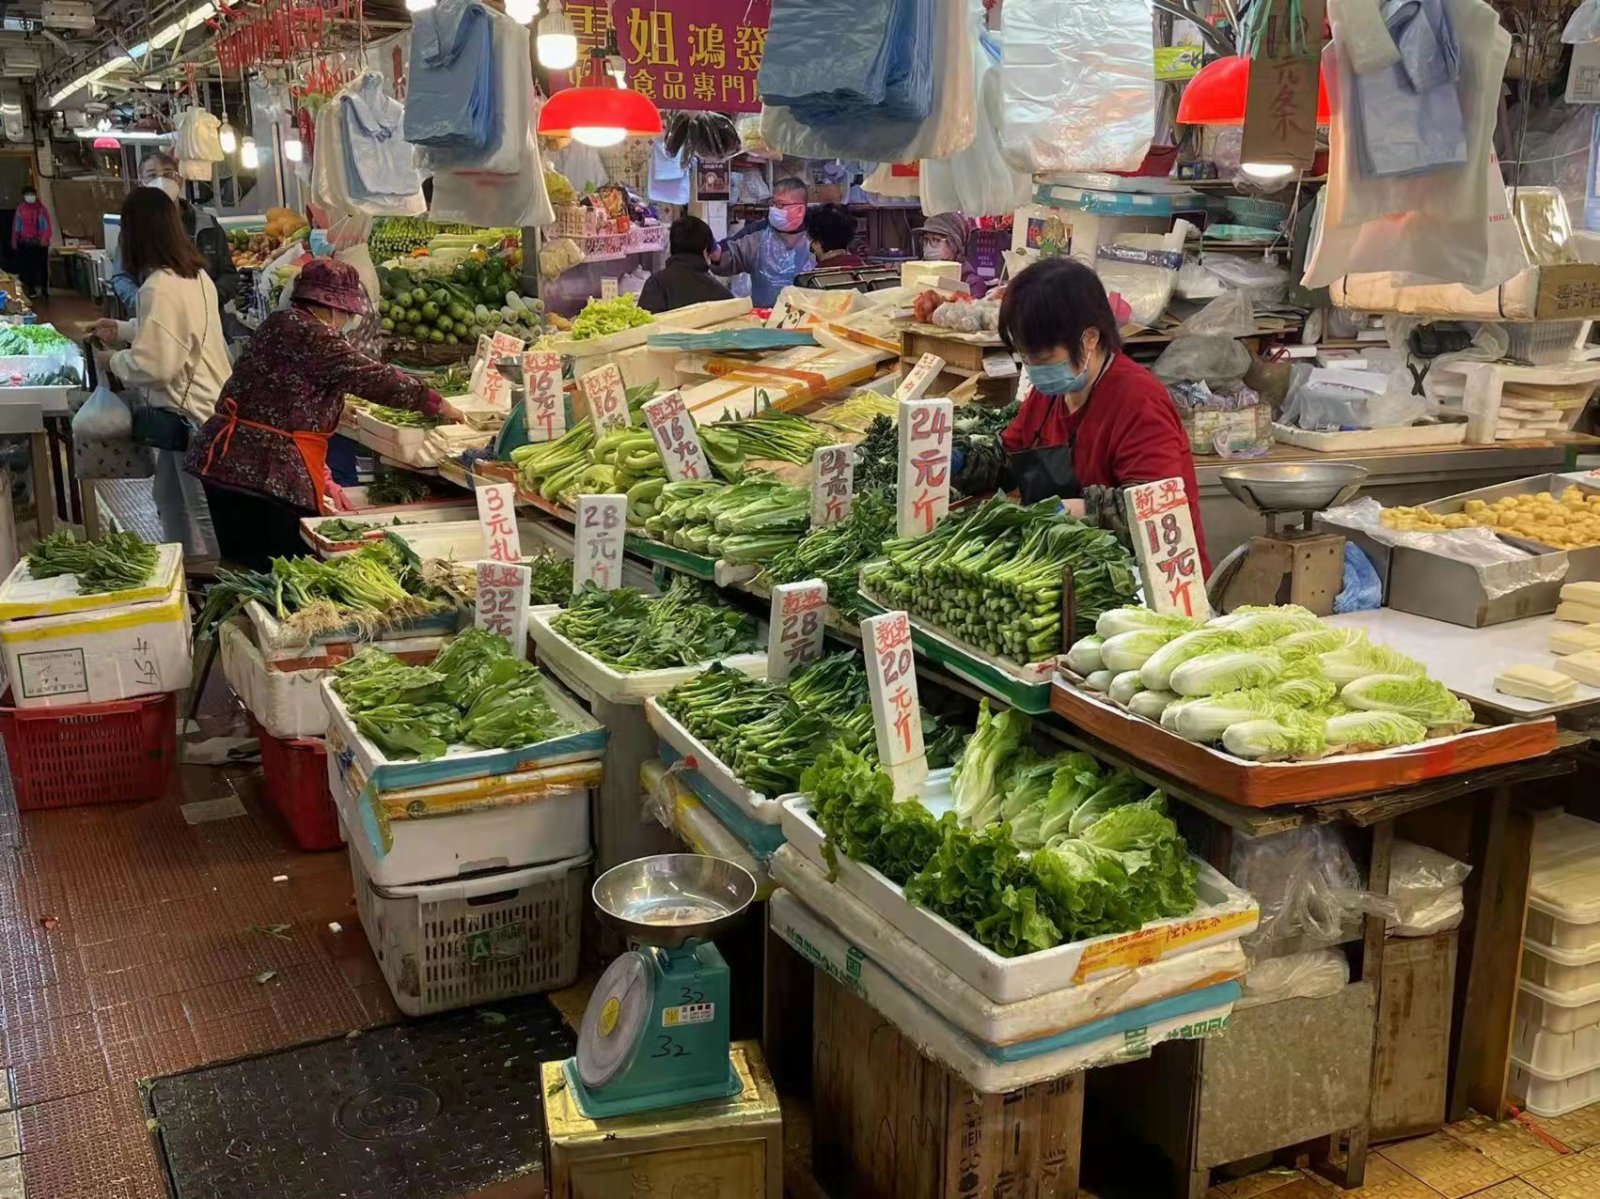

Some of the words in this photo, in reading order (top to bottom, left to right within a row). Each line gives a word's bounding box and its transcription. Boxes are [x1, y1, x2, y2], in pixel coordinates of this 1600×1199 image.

[630, 68, 764, 103] 食品專門
[529, 372, 554, 395] 16
[657, 417, 685, 450] 16
[911, 407, 951, 446] 24
[820, 449, 850, 477] 24
[584, 505, 620, 529] 28
[1144, 513, 1182, 555] 18
[480, 588, 516, 615] 32
[780, 611, 818, 643] 28
[880, 648, 912, 686] 20
[679, 986, 708, 1006] 32
[652, 1034, 692, 1058] 32
